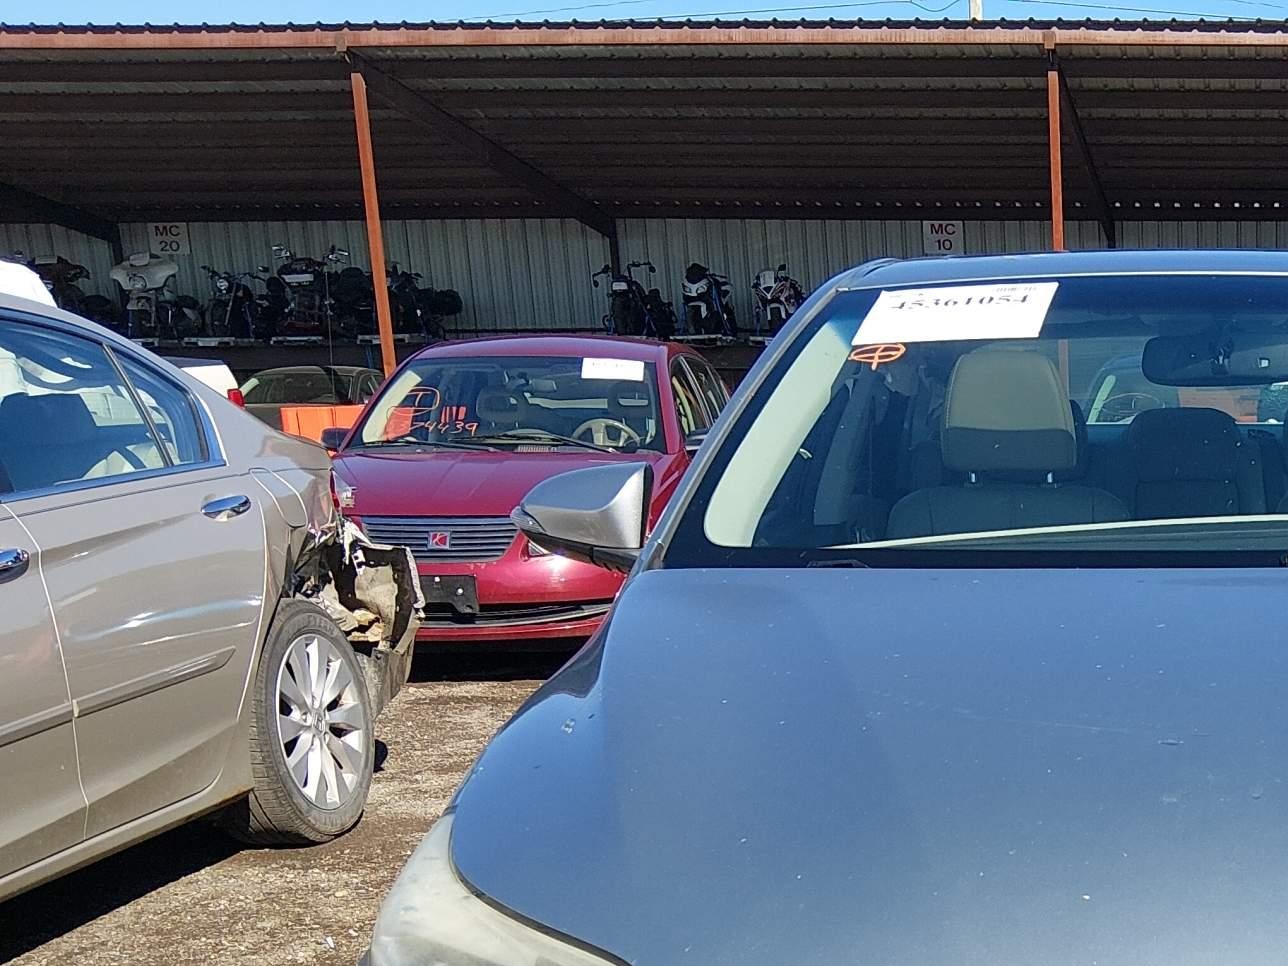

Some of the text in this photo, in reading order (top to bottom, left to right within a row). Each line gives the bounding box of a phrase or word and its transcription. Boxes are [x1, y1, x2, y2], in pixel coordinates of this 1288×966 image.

[154, 224, 180, 237] MC
[930, 223, 957, 236] MC
[159, 240, 180, 252] 20
[935, 239, 953, 251] 10
